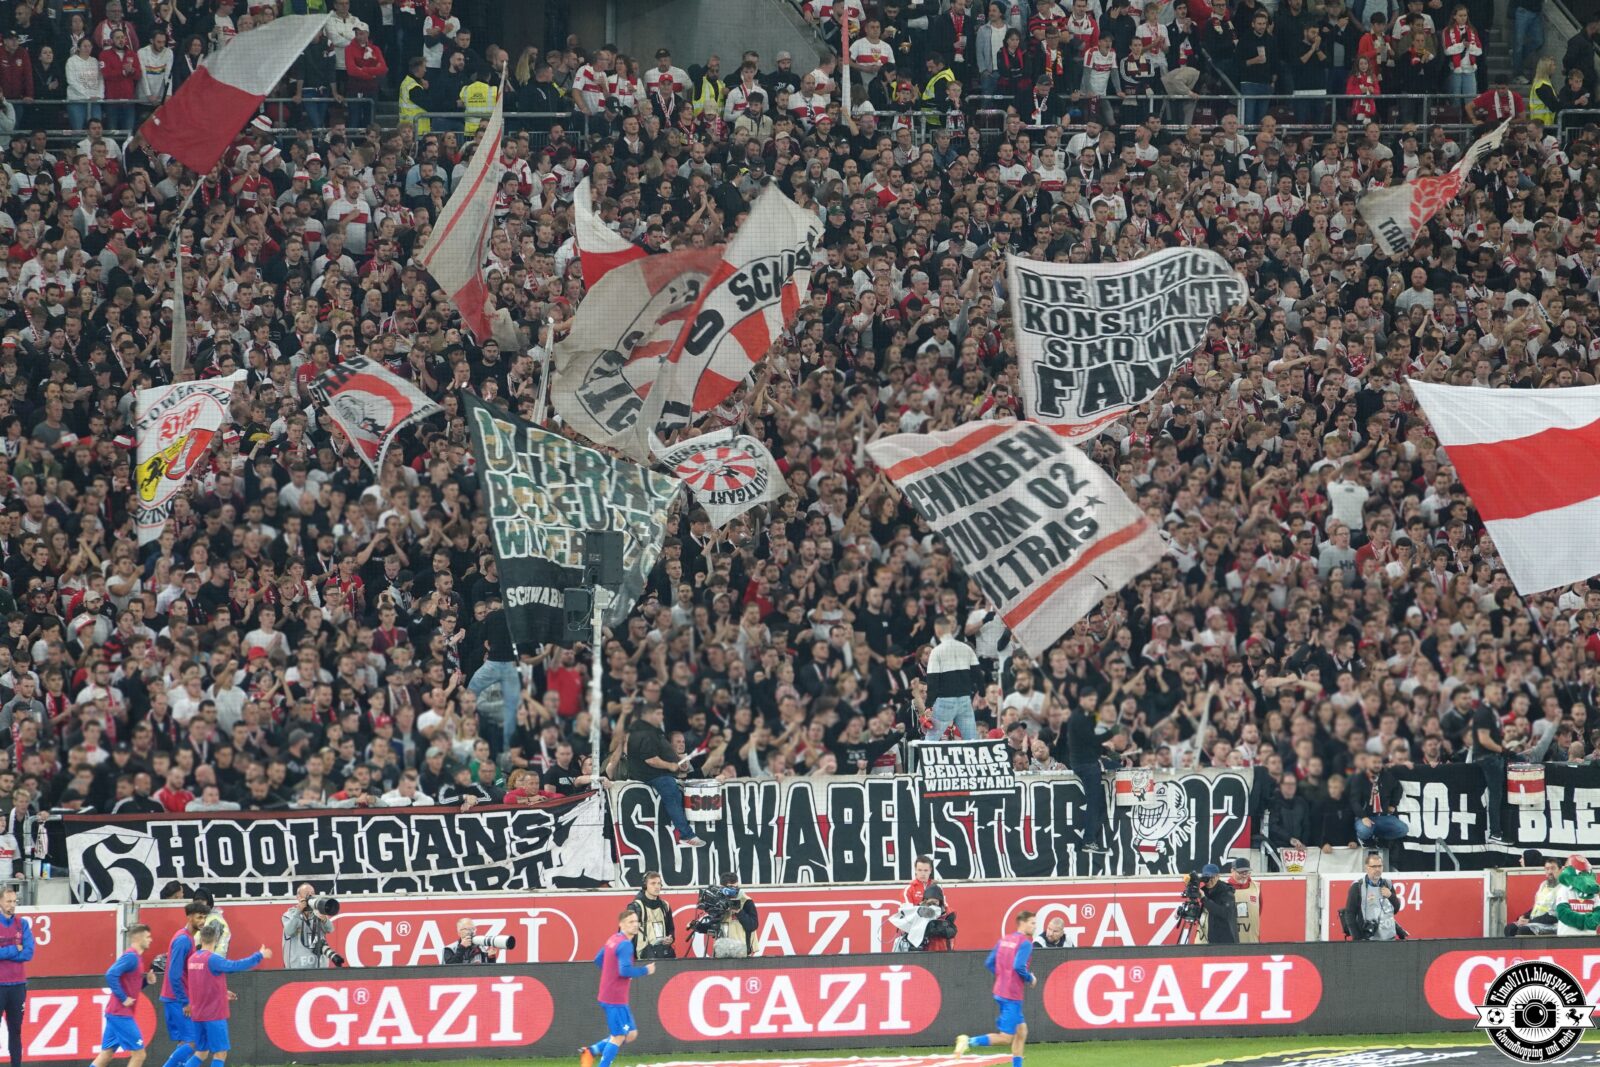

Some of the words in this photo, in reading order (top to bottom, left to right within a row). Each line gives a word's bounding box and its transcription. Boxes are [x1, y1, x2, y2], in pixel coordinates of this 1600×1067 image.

[1020, 272, 1087, 304] DIE
[1024, 281, 1242, 339] KONSTANTE
[1046, 336, 1136, 370] SIND
[1026, 462, 1091, 510] 02
[922, 743, 1009, 764] ULTRAS
[923, 761, 1012, 779] BEDEUTET
[924, 775, 1015, 792] WIDERSTAND
[1176, 773, 1250, 876] 02
[147, 809, 555, 879] HOOLIGANS
